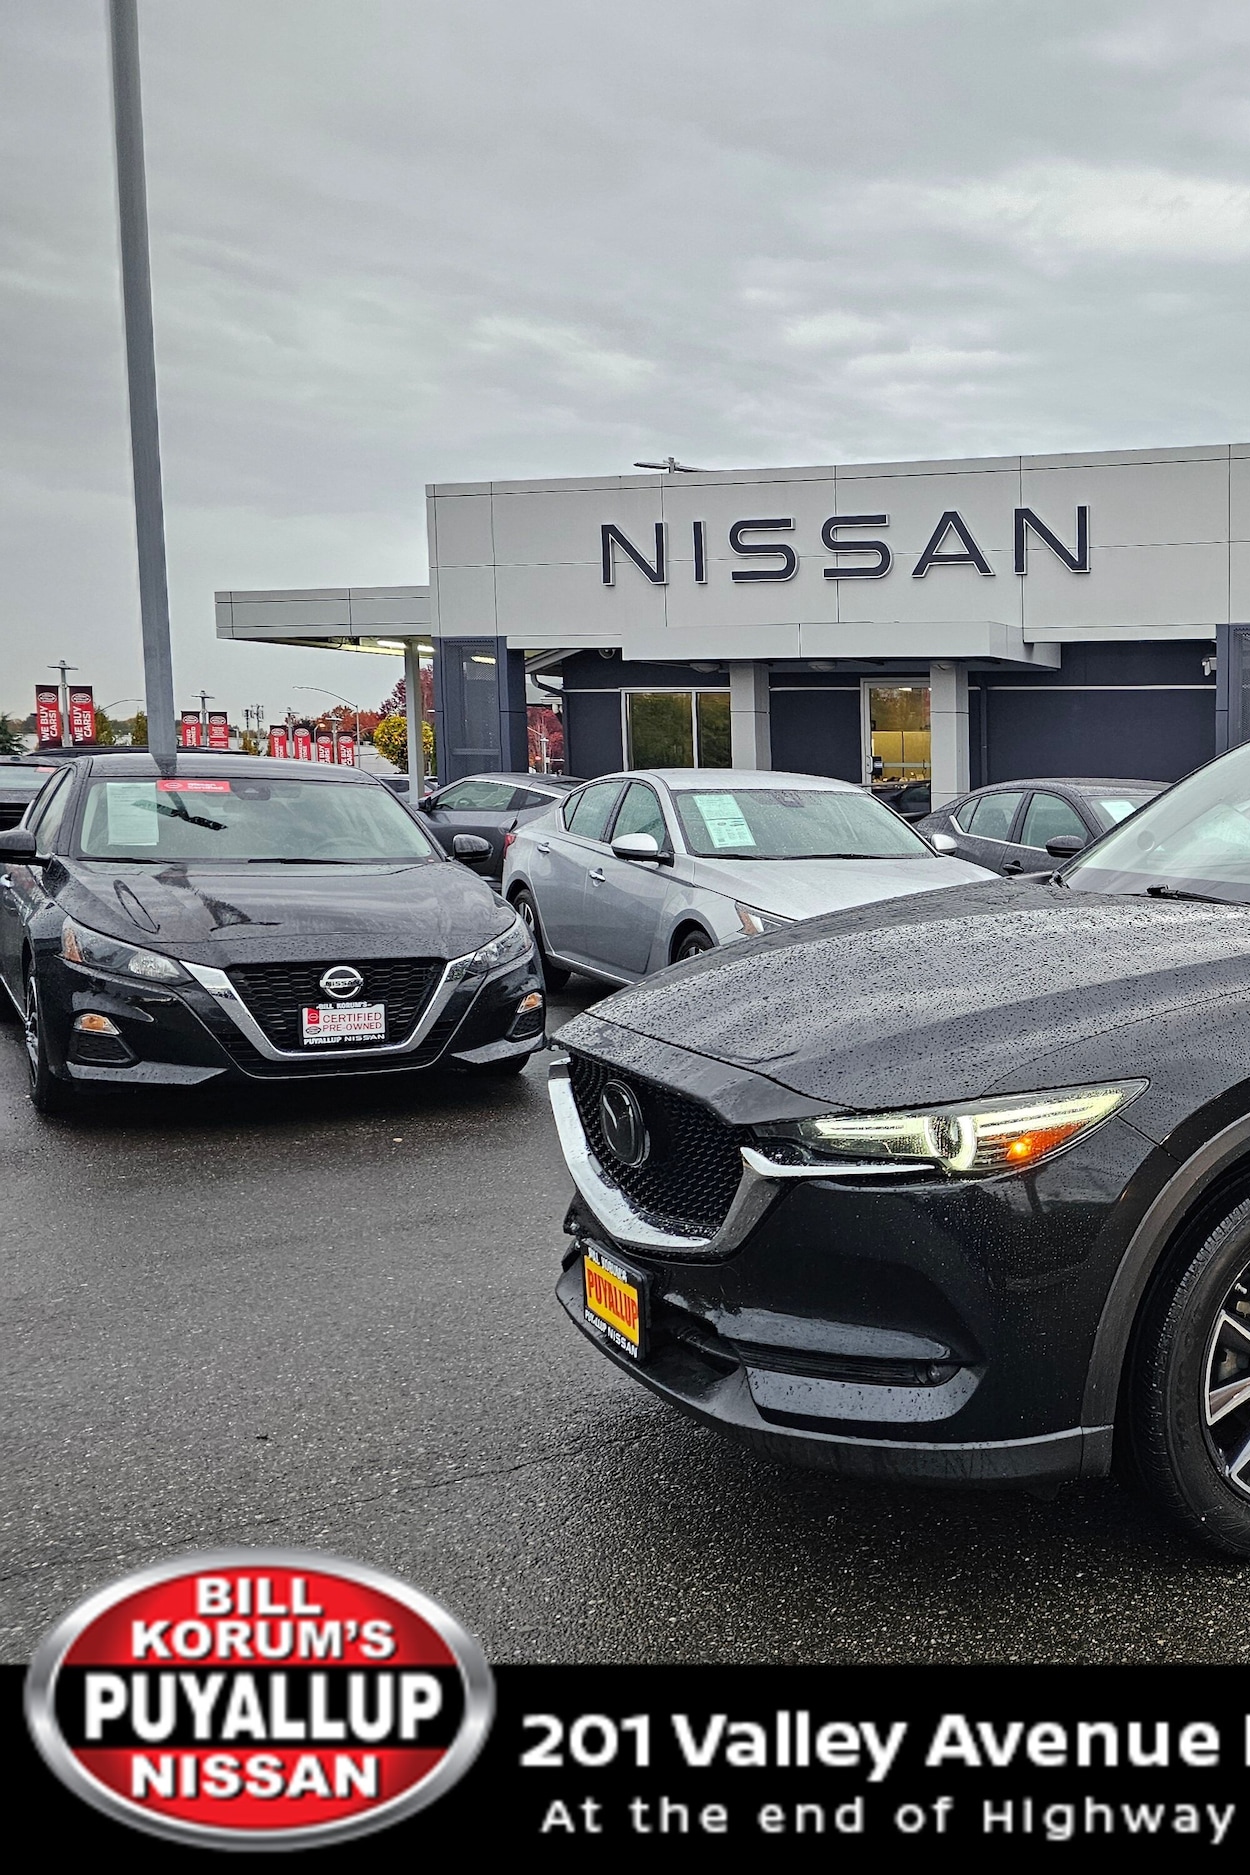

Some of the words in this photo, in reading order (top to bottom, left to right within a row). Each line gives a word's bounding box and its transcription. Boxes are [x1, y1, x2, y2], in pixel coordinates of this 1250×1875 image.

[600, 504, 1091, 587] NISSAN
[40, 705, 48, 725] BUY
[49, 710, 58, 737] CARS!
[73, 706, 83, 725] BUY
[83, 710, 92, 738] CARS!
[41, 726, 50, 741] WE
[74, 726, 84, 742] WE
[323, 1012, 382, 1023] CERTIFIED
[323, 1021, 382, 1031] PRE-OWNED
[303, 1036, 342, 1045] PUYALLUP
[344, 1033, 385, 1042] NISSAN
[586, 1268, 638, 1331] PUYALLUP
[607, 1326, 639, 1359] NISSAN
